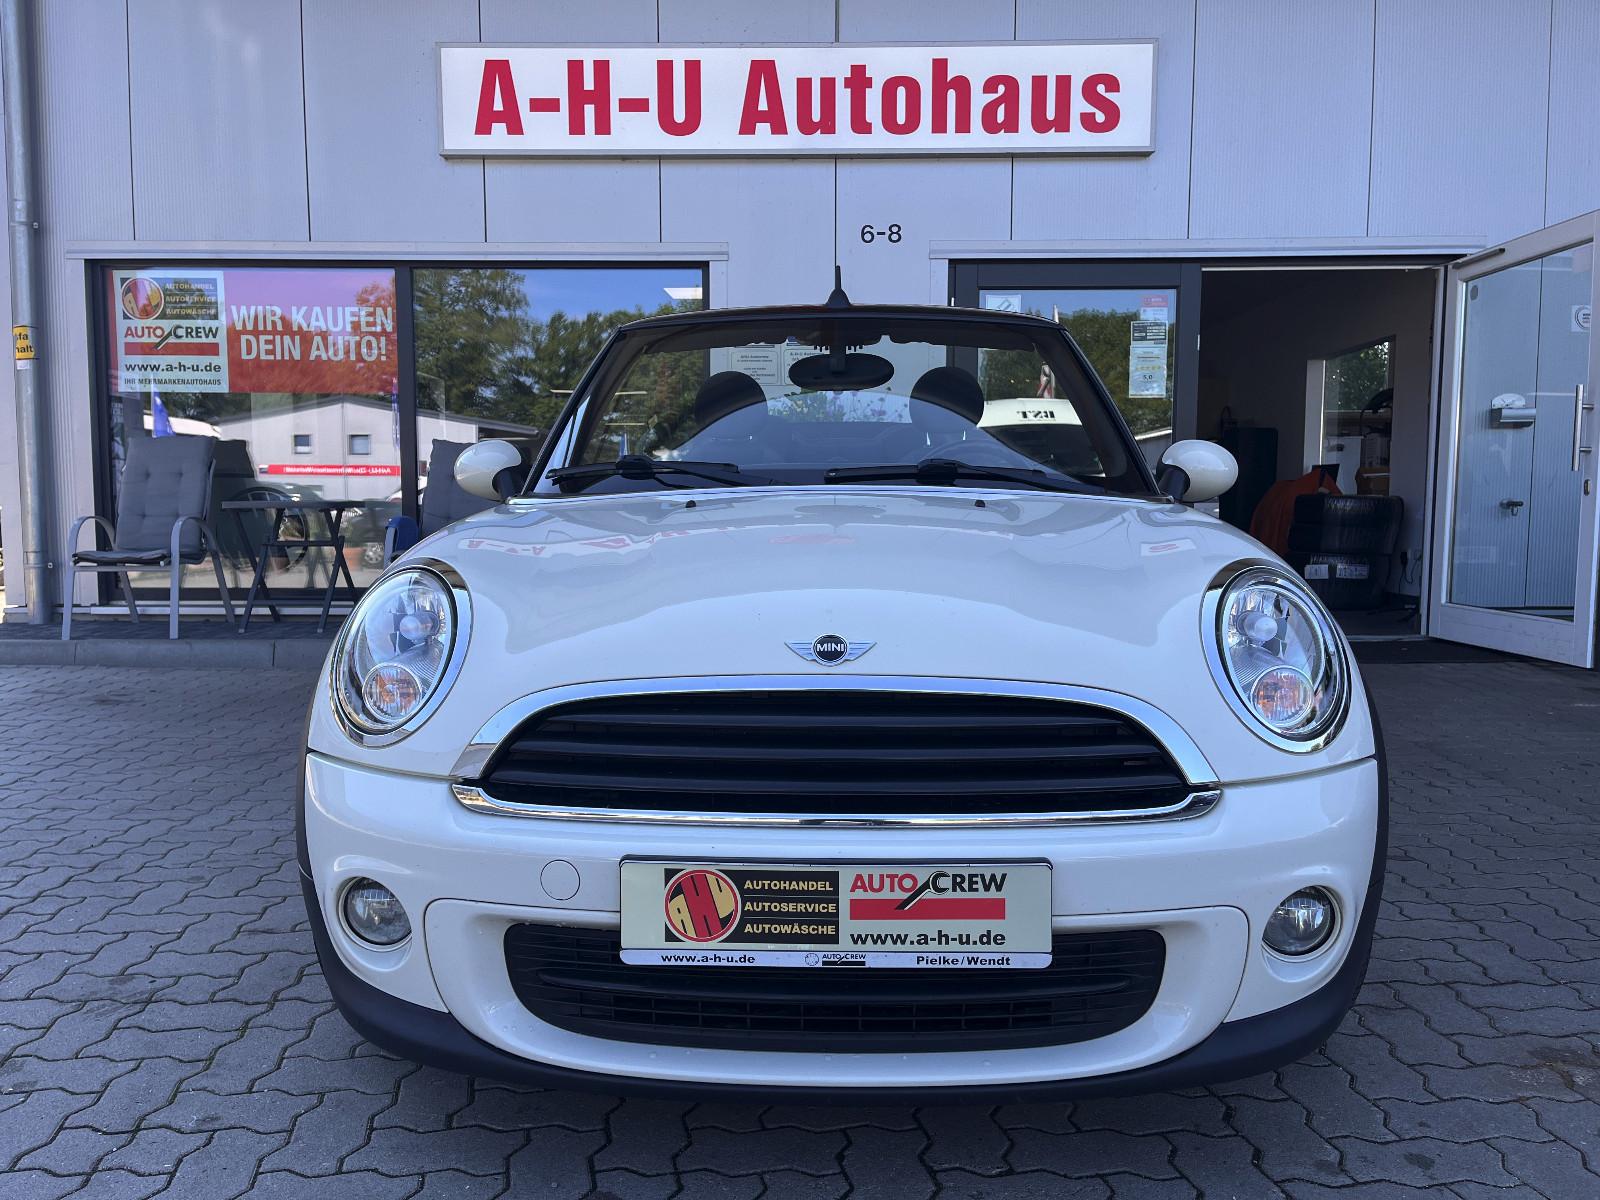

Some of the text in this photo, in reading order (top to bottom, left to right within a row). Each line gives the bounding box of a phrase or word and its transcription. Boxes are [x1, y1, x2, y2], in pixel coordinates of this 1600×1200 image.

[474, 57, 1121, 136] A-H-U Autohaus
[861, 224, 902, 243] 6-8
[165, 295, 216, 303] AUTOSERVICE
[166, 306, 217, 315] AUTOWÄSCHE
[231, 305, 393, 332] WIR KAUFEN
[124, 324, 219, 339] AUTO CREW
[240, 335, 387, 361] DEIN AUTO!
[125, 362, 222, 372] www.a-h-u.de
[816, 643, 845, 652] MINI
[744, 880, 833, 891] AUTOHANDEL
[850, 871, 1007, 894] AUTO CREW
[744, 902, 837, 913] AUTOSERVICE
[744, 923, 836, 934] AUTOWÄSCHE
[850, 930, 1006, 945] www.a-h-u.de
[661, 954, 756, 963] www.a-h-u.de
